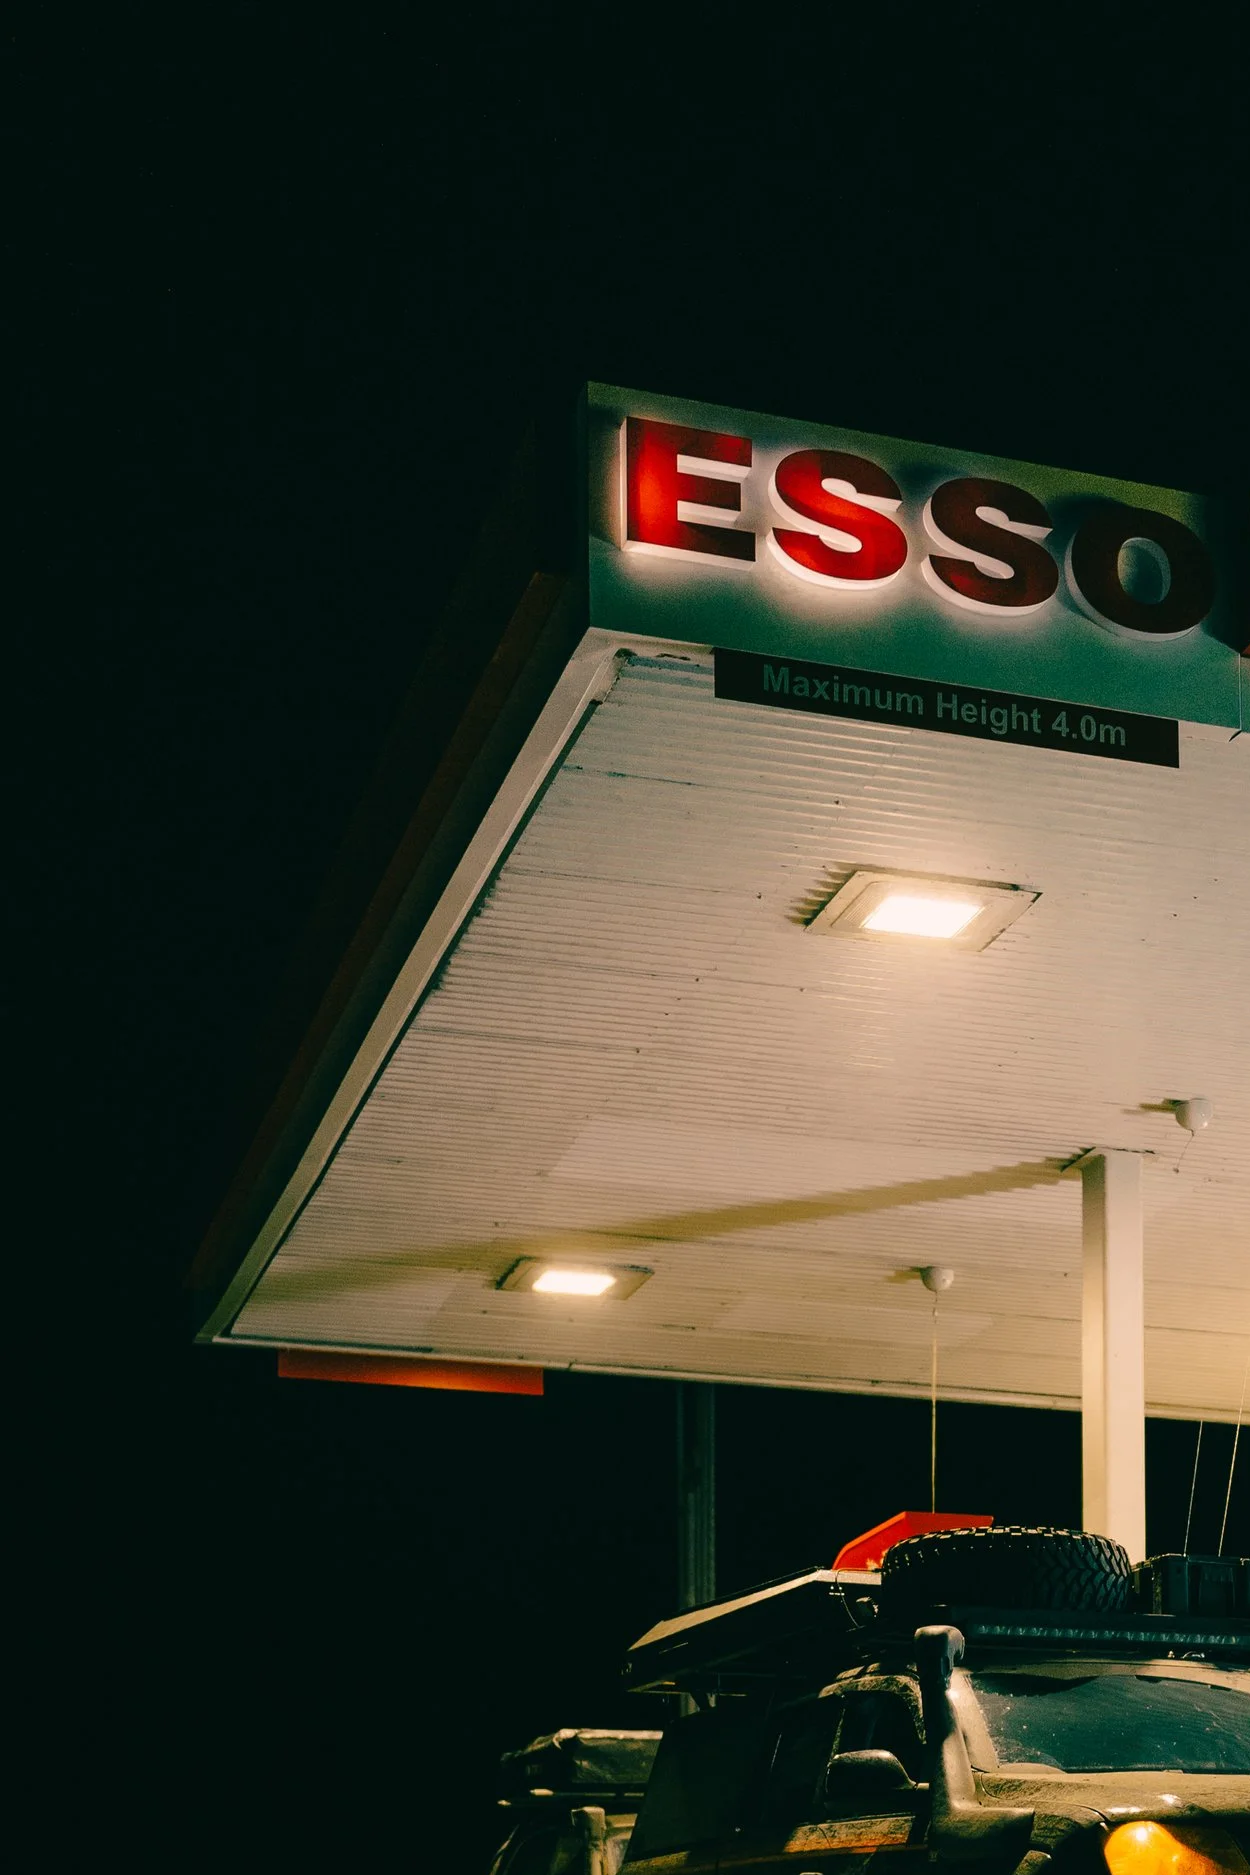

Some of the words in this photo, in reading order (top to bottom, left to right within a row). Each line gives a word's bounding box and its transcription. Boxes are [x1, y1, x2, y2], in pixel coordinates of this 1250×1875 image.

[621, 416, 1215, 640] ESSO
[763, 663, 924, 716] Maximum
[937, 692, 1041, 735] Height
[1052, 710, 1127, 746] 4.0m
